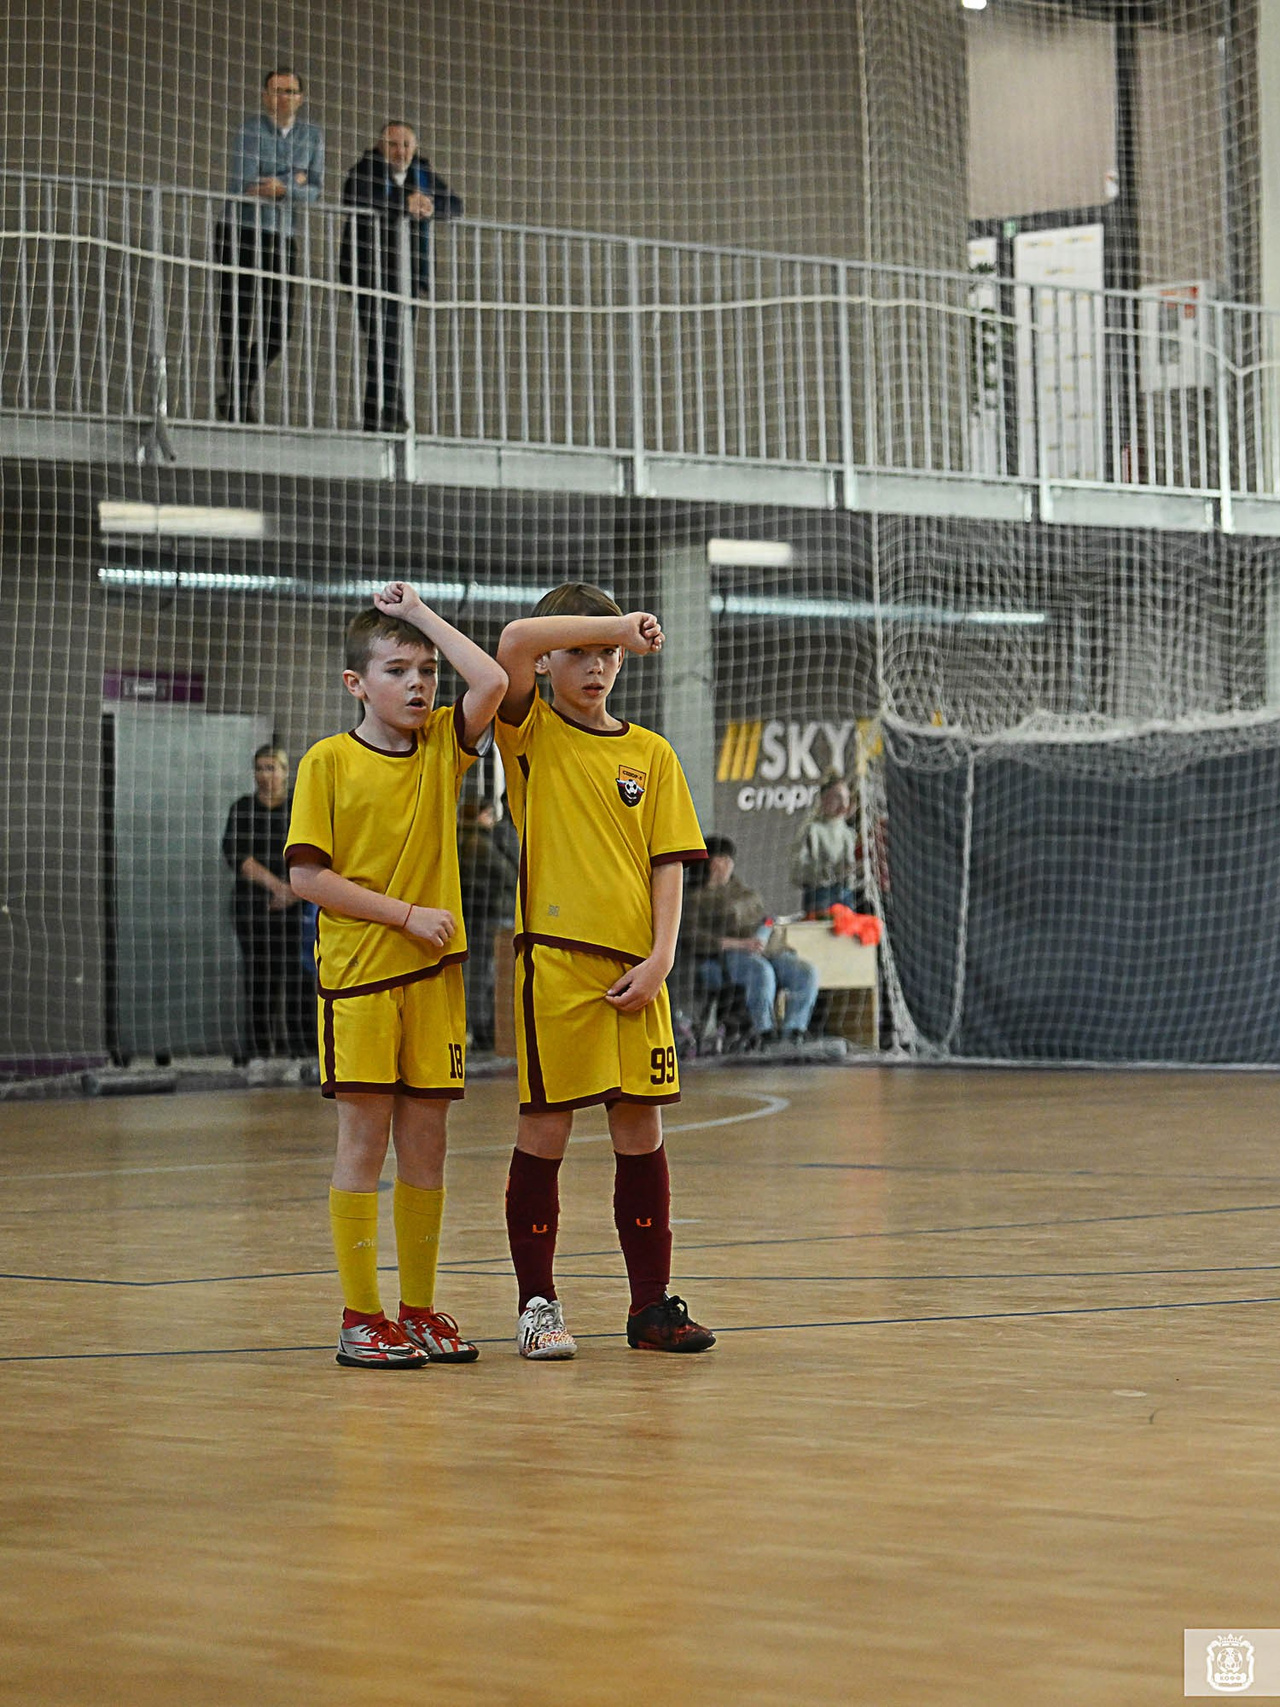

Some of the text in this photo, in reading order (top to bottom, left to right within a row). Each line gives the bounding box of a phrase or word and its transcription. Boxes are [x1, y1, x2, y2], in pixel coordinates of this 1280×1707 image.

[761, 720, 855, 780] SKY
[448, 1043, 463, 1080] 18
[650, 1046, 675, 1085] 99
